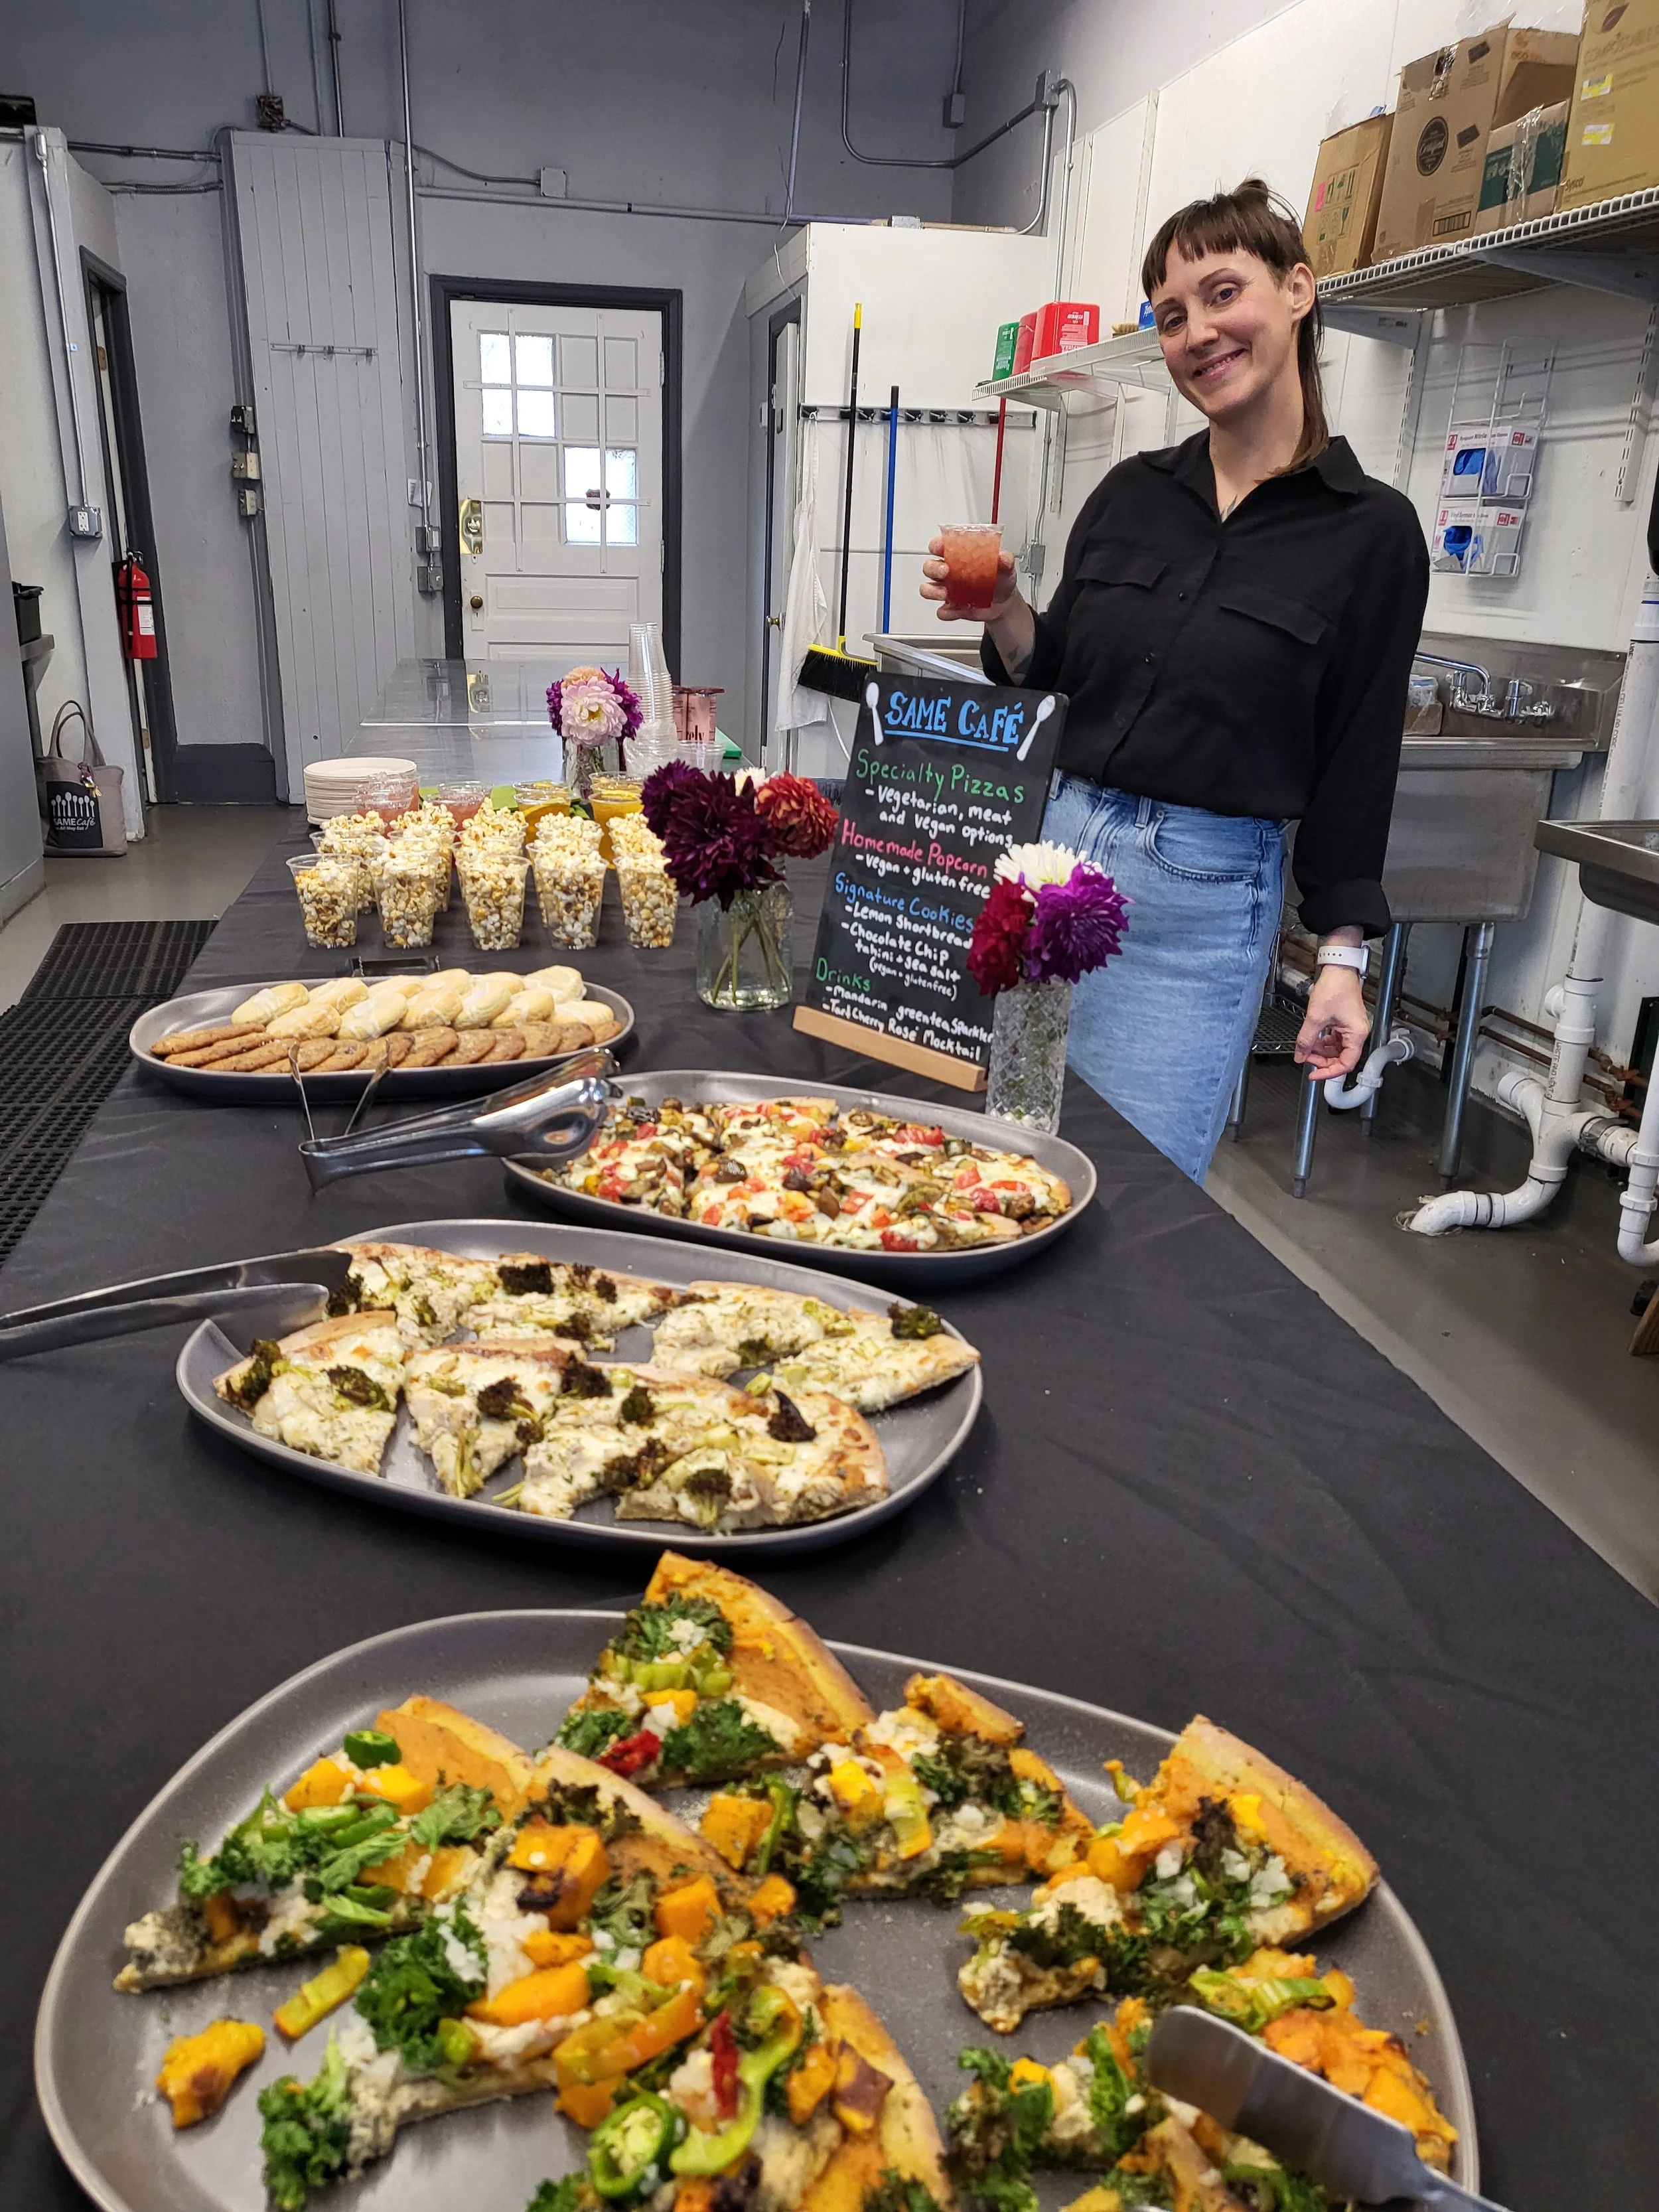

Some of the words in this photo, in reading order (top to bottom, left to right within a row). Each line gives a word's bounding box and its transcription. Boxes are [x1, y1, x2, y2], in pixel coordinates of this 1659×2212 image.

[885, 691, 951, 733] SAME
[958, 700, 1024, 744] CAFÉ
[856, 749, 944, 802] Specialty
[951, 764, 1024, 804] Pizzas
[879, 810, 906, 825] and
[962, 825, 1013, 848] options
[968, 805, 1012, 825] meat
[841, 818, 924, 862] Homemade
[928, 842, 987, 879] Popcorn
[835, 871, 905, 911] Signature
[909, 897, 974, 933] Cookies
[855, 938, 894, 962] tahini
[816, 957, 871, 992] Drinks
[923, 1029, 981, 1062] Mocktail
